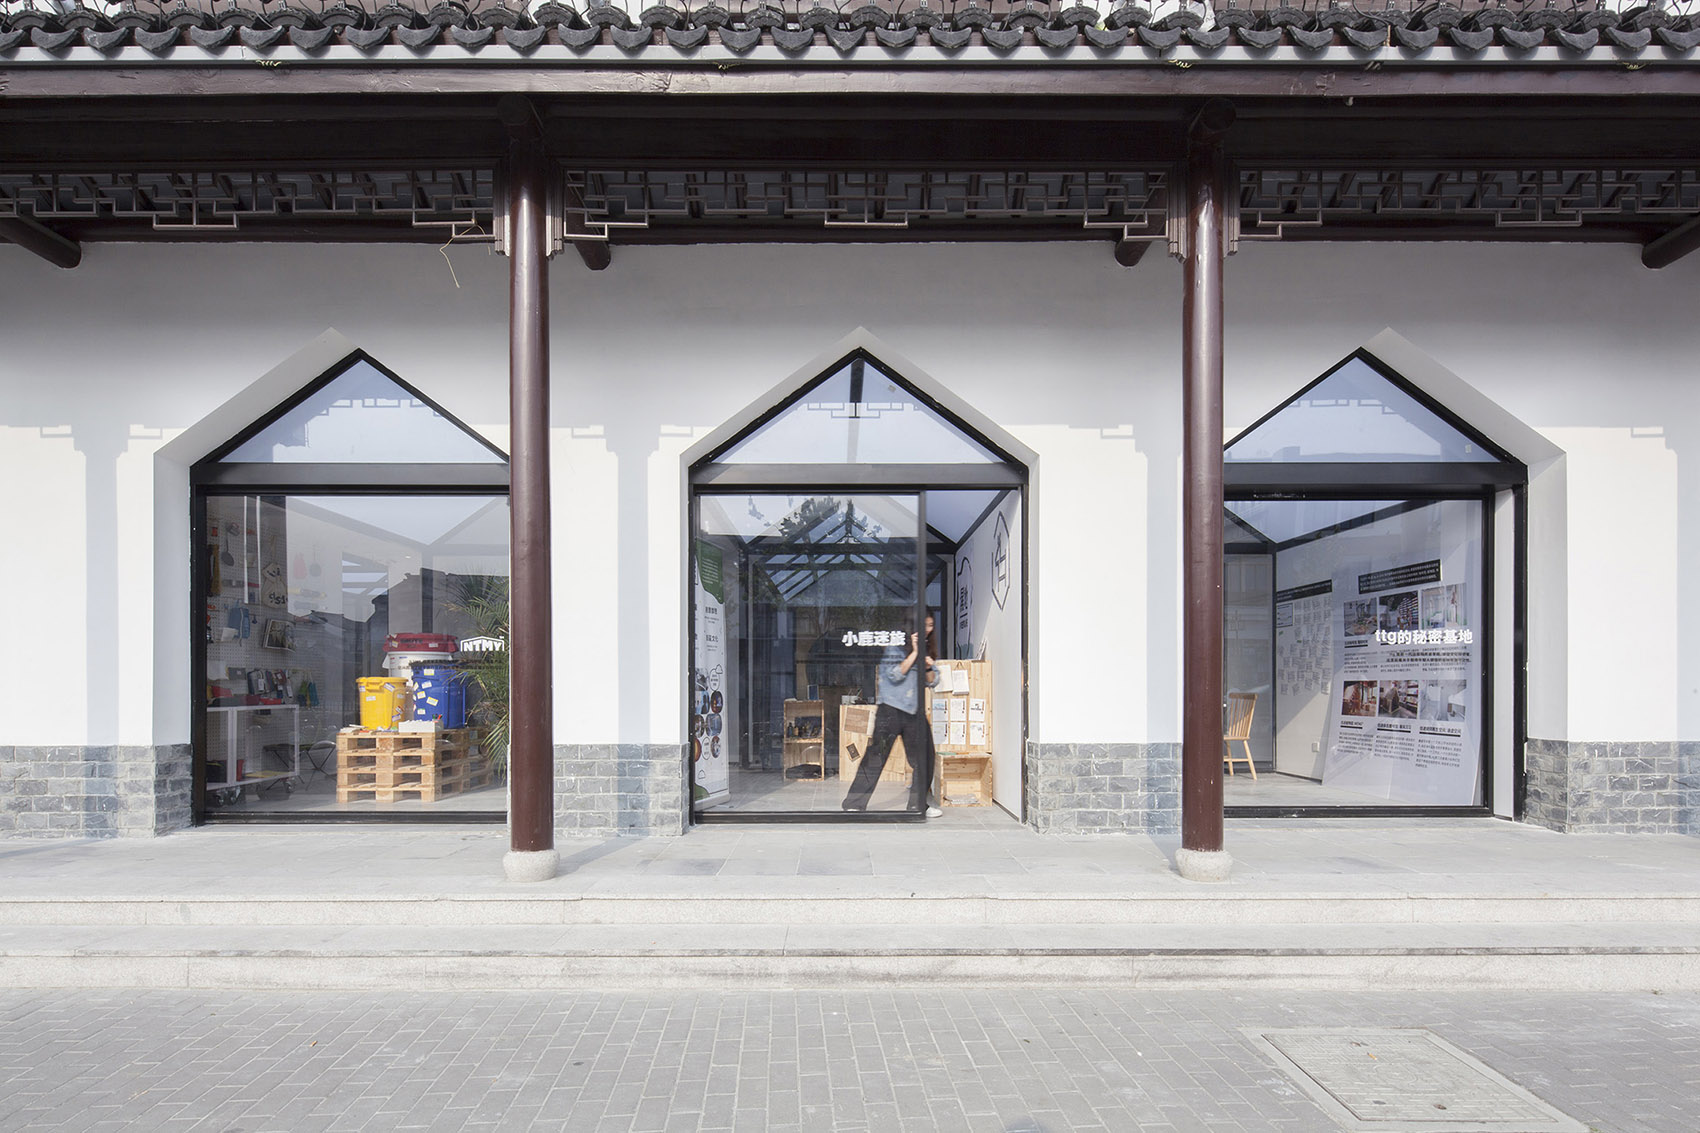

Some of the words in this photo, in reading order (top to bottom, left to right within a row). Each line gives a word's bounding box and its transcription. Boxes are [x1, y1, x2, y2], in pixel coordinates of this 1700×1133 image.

[842, 630, 906, 647] 小鹿迷旅
[1375, 629, 1473, 645] ttg的秘密基地
[463, 639, 502, 652] NTMY
